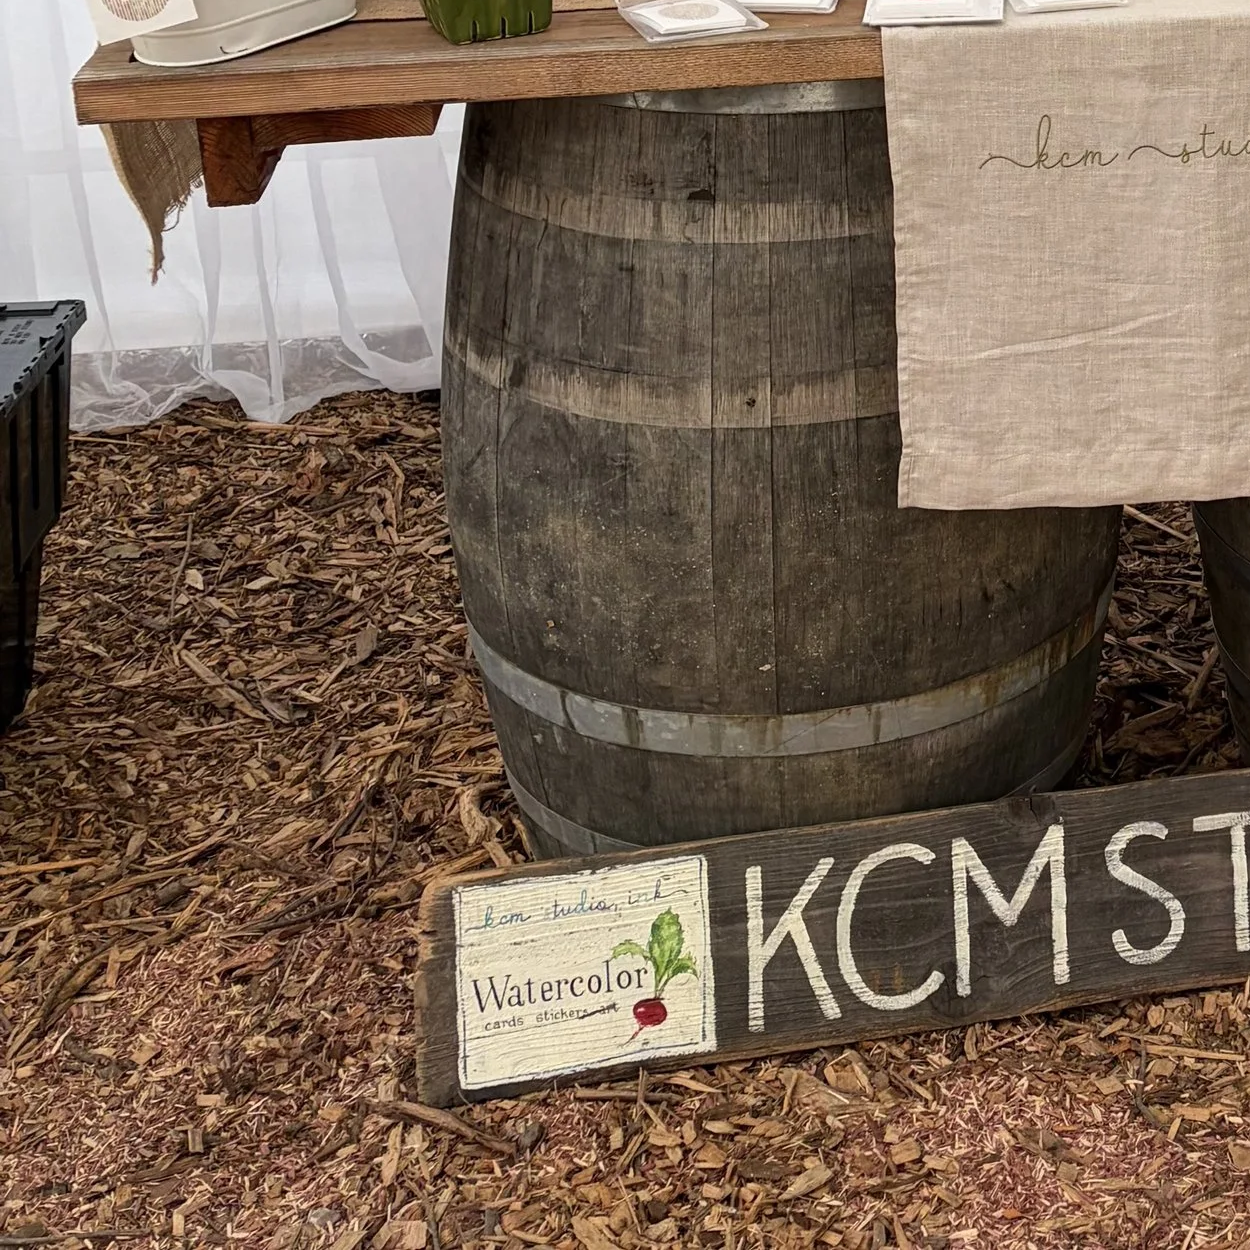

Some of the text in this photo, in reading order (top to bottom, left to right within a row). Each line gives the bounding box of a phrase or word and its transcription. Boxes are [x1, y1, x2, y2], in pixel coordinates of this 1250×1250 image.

[980, 115, 1119, 170] kcm
[552, 889, 619, 919] tudio,
[745, 819, 1071, 1033] KCM
[471, 959, 649, 1015] Watercolor
[484, 1017, 525, 1032] cards
[536, 1007, 589, 1023] stickers
